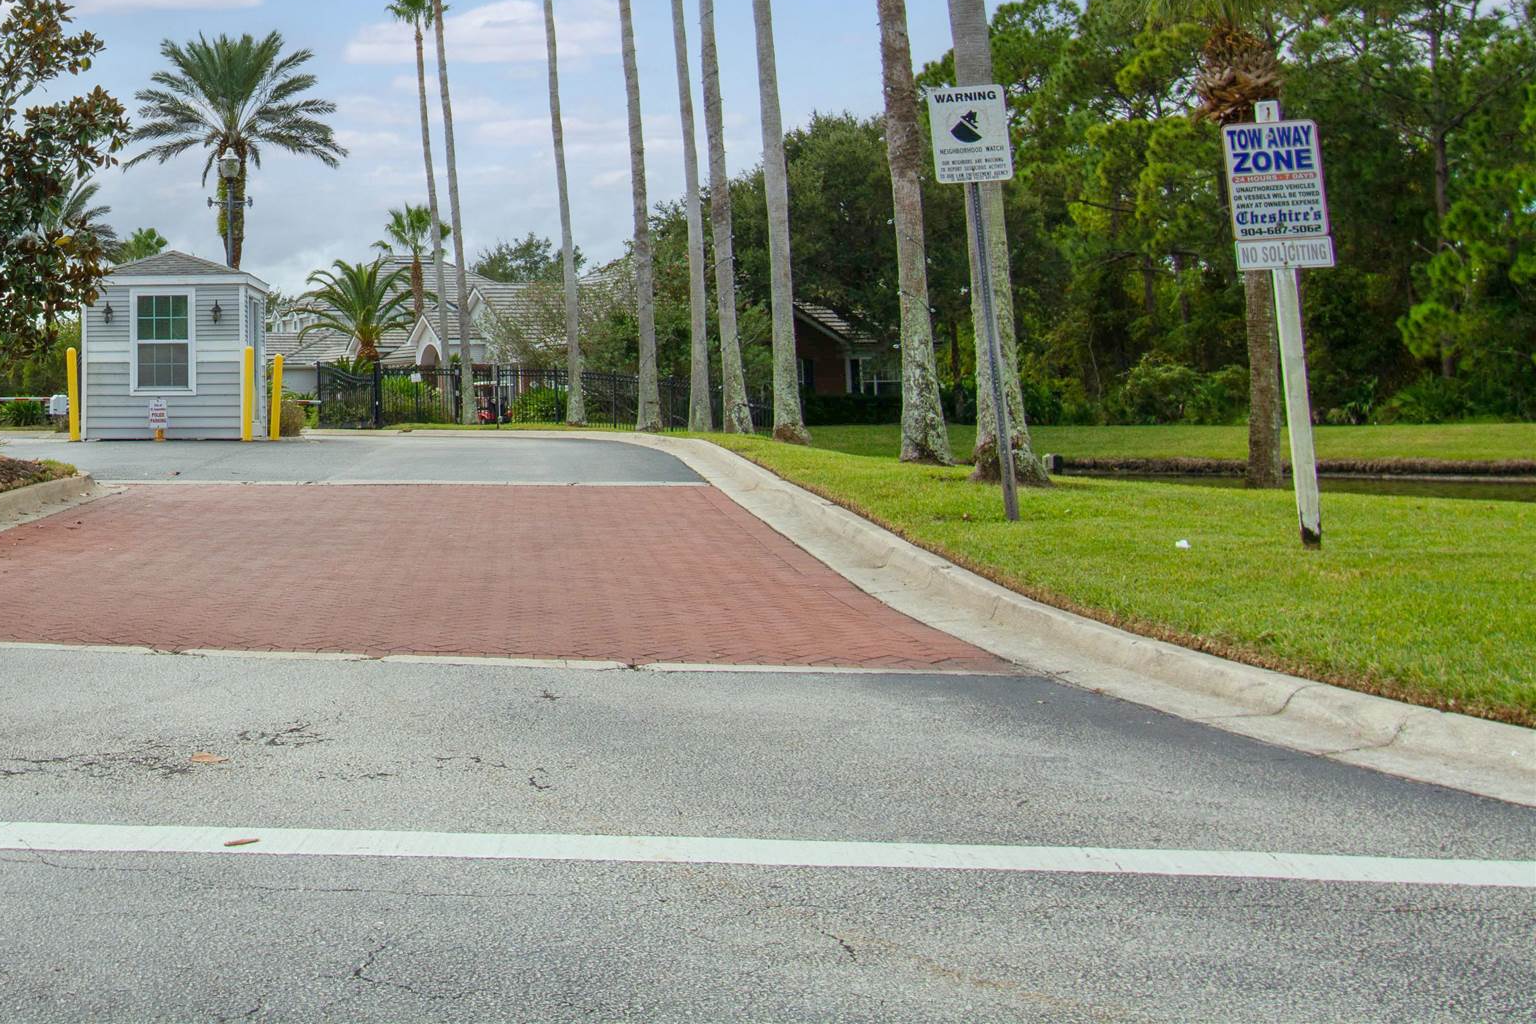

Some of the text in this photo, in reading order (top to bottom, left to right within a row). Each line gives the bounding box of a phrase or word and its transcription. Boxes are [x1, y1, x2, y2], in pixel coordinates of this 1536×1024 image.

[934, 91, 996, 103] WARNING
[1226, 125, 1312, 151] TOW AWAY
[940, 146, 982, 154] NEIGHBORHOOD
[1233, 149, 1313, 173] ZONE
[1247, 175, 1277, 183] HOURS
[1236, 182, 1315, 193] UNAUTHORIZED VEHICLES
[1244, 193, 1271, 201] VESSELS
[1264, 200, 1290, 208] OWNERS
[1236, 206, 1322, 225] Cheshire's
[1240, 224, 1322, 236] 904-687-5062
[1241, 243, 1327, 264] NO SOLICITING
